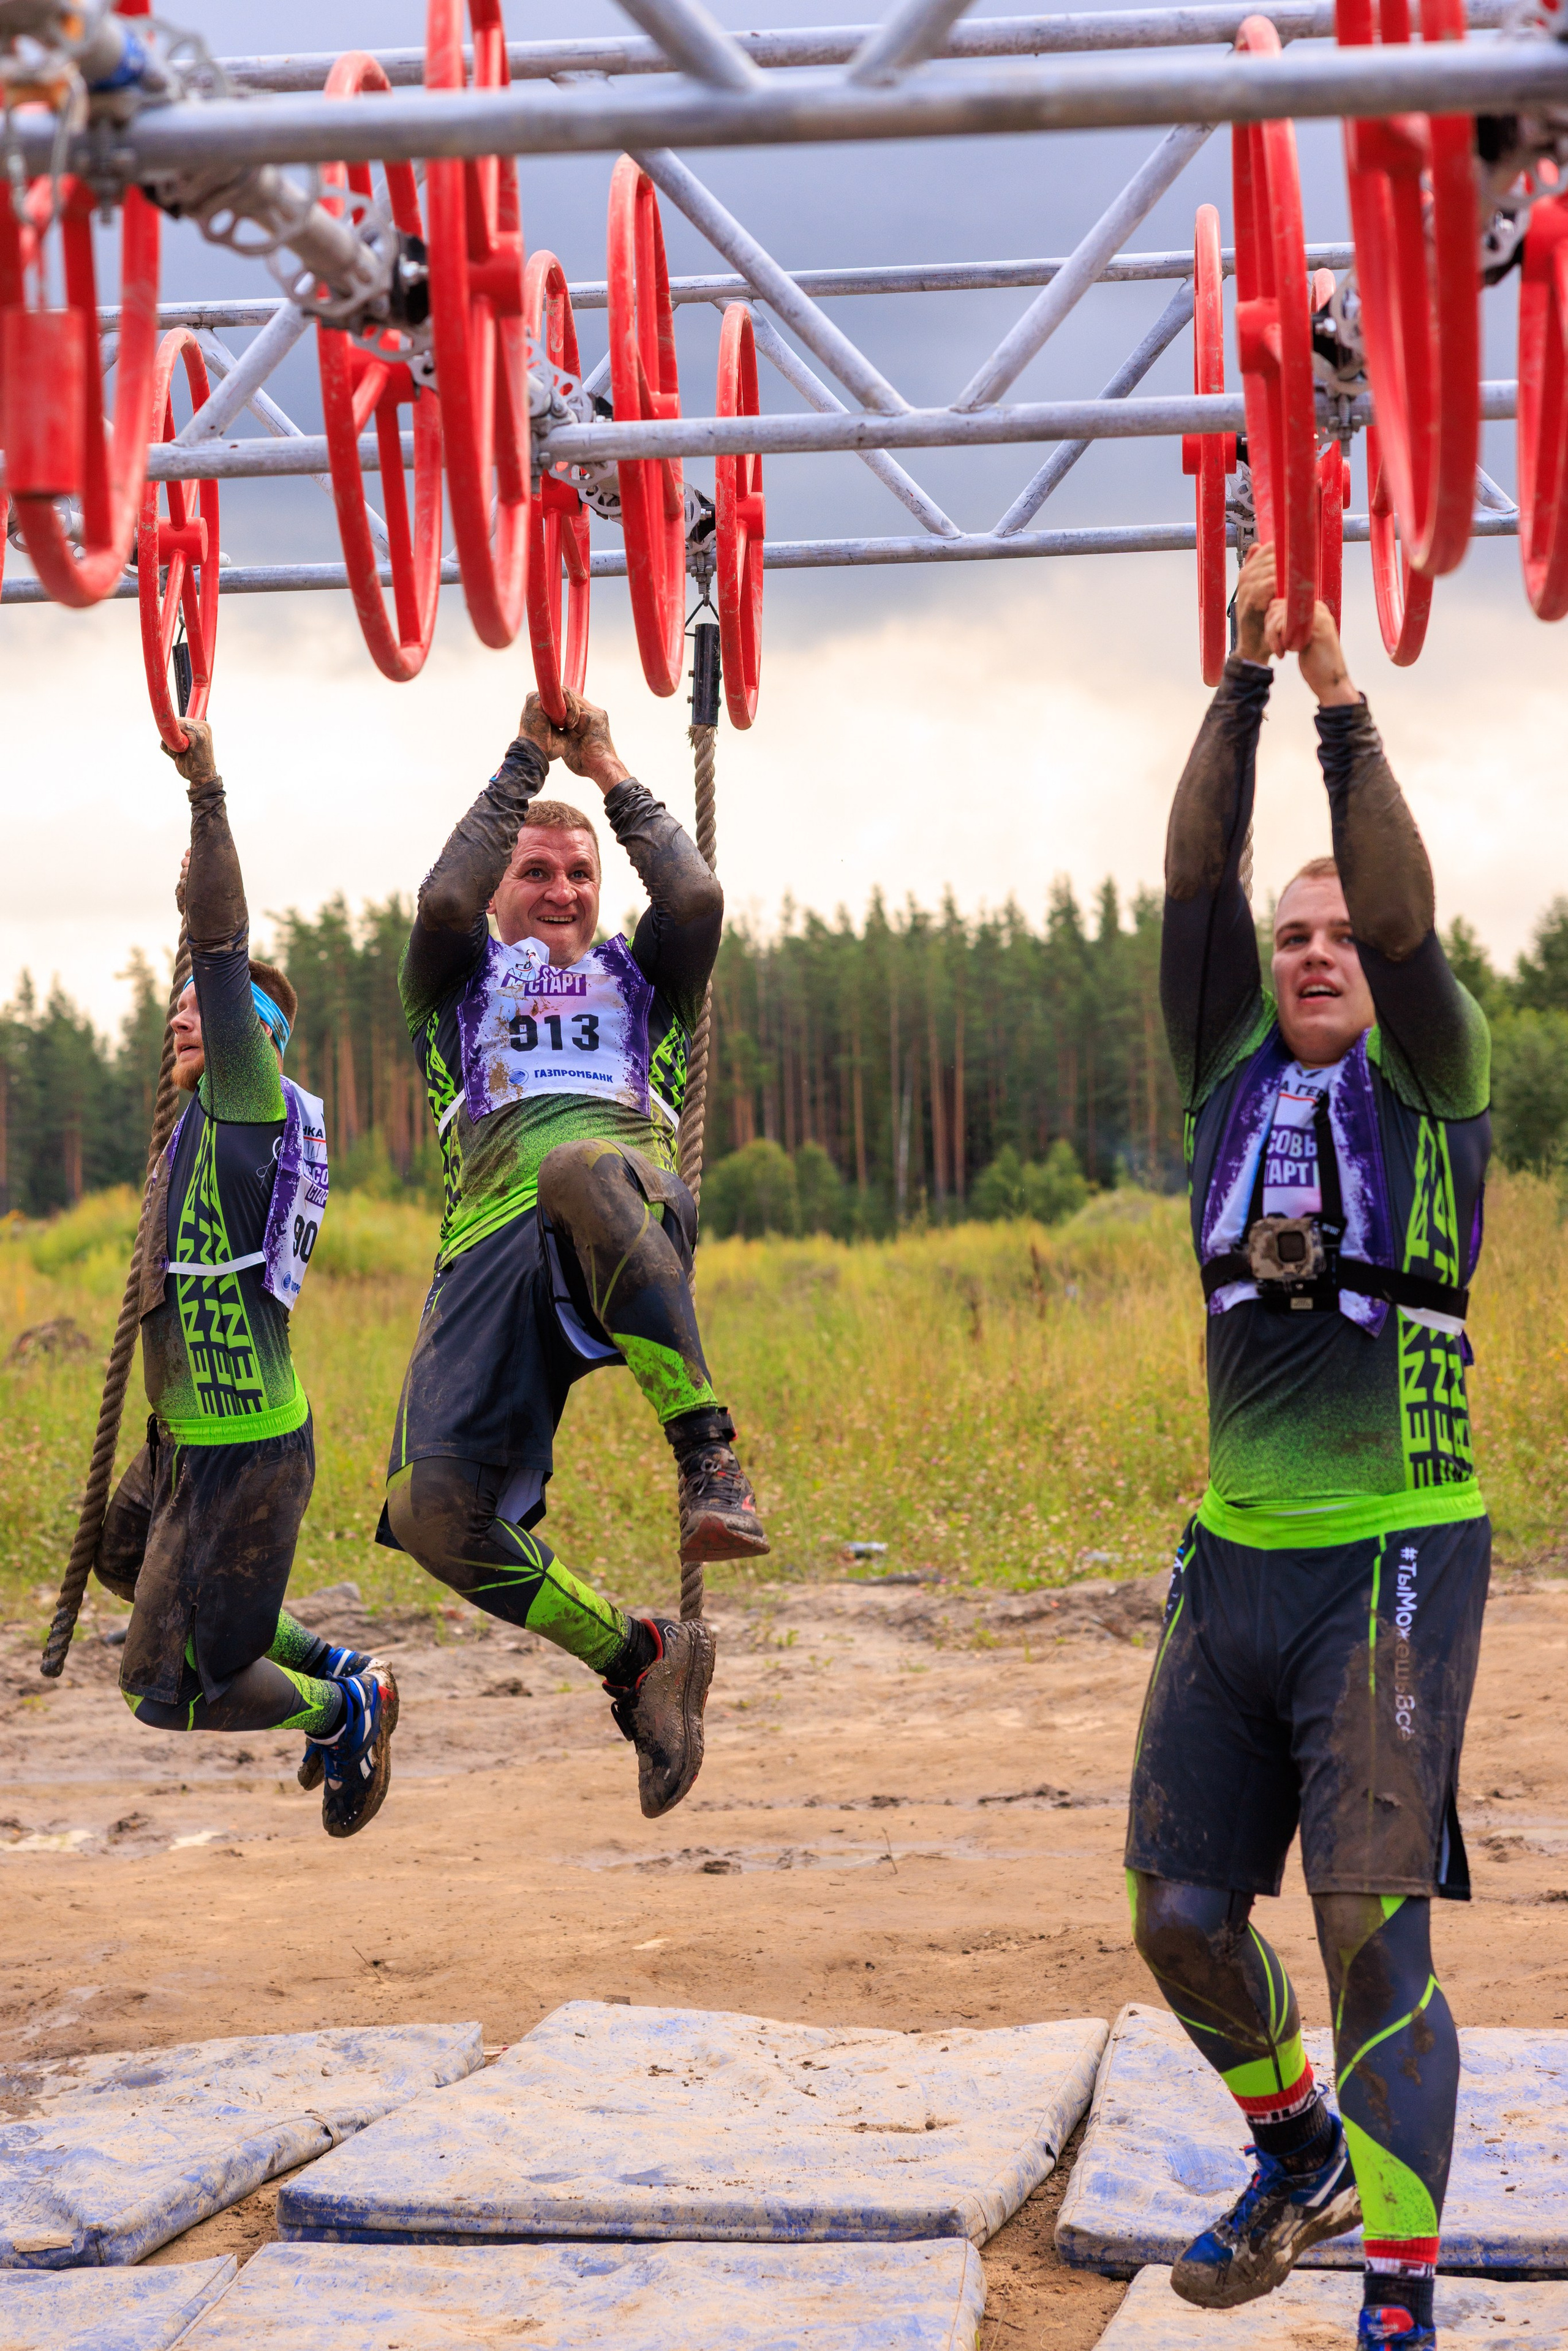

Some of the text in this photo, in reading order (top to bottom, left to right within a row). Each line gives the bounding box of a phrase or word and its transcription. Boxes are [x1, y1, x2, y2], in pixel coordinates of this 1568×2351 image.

[528, 973, 582, 994] СТАРТ
[509, 1014, 600, 1052] 913
[533, 1069, 614, 1084] ГАЗПРОМБАНК
[307, 1183, 329, 1206] СТАР
